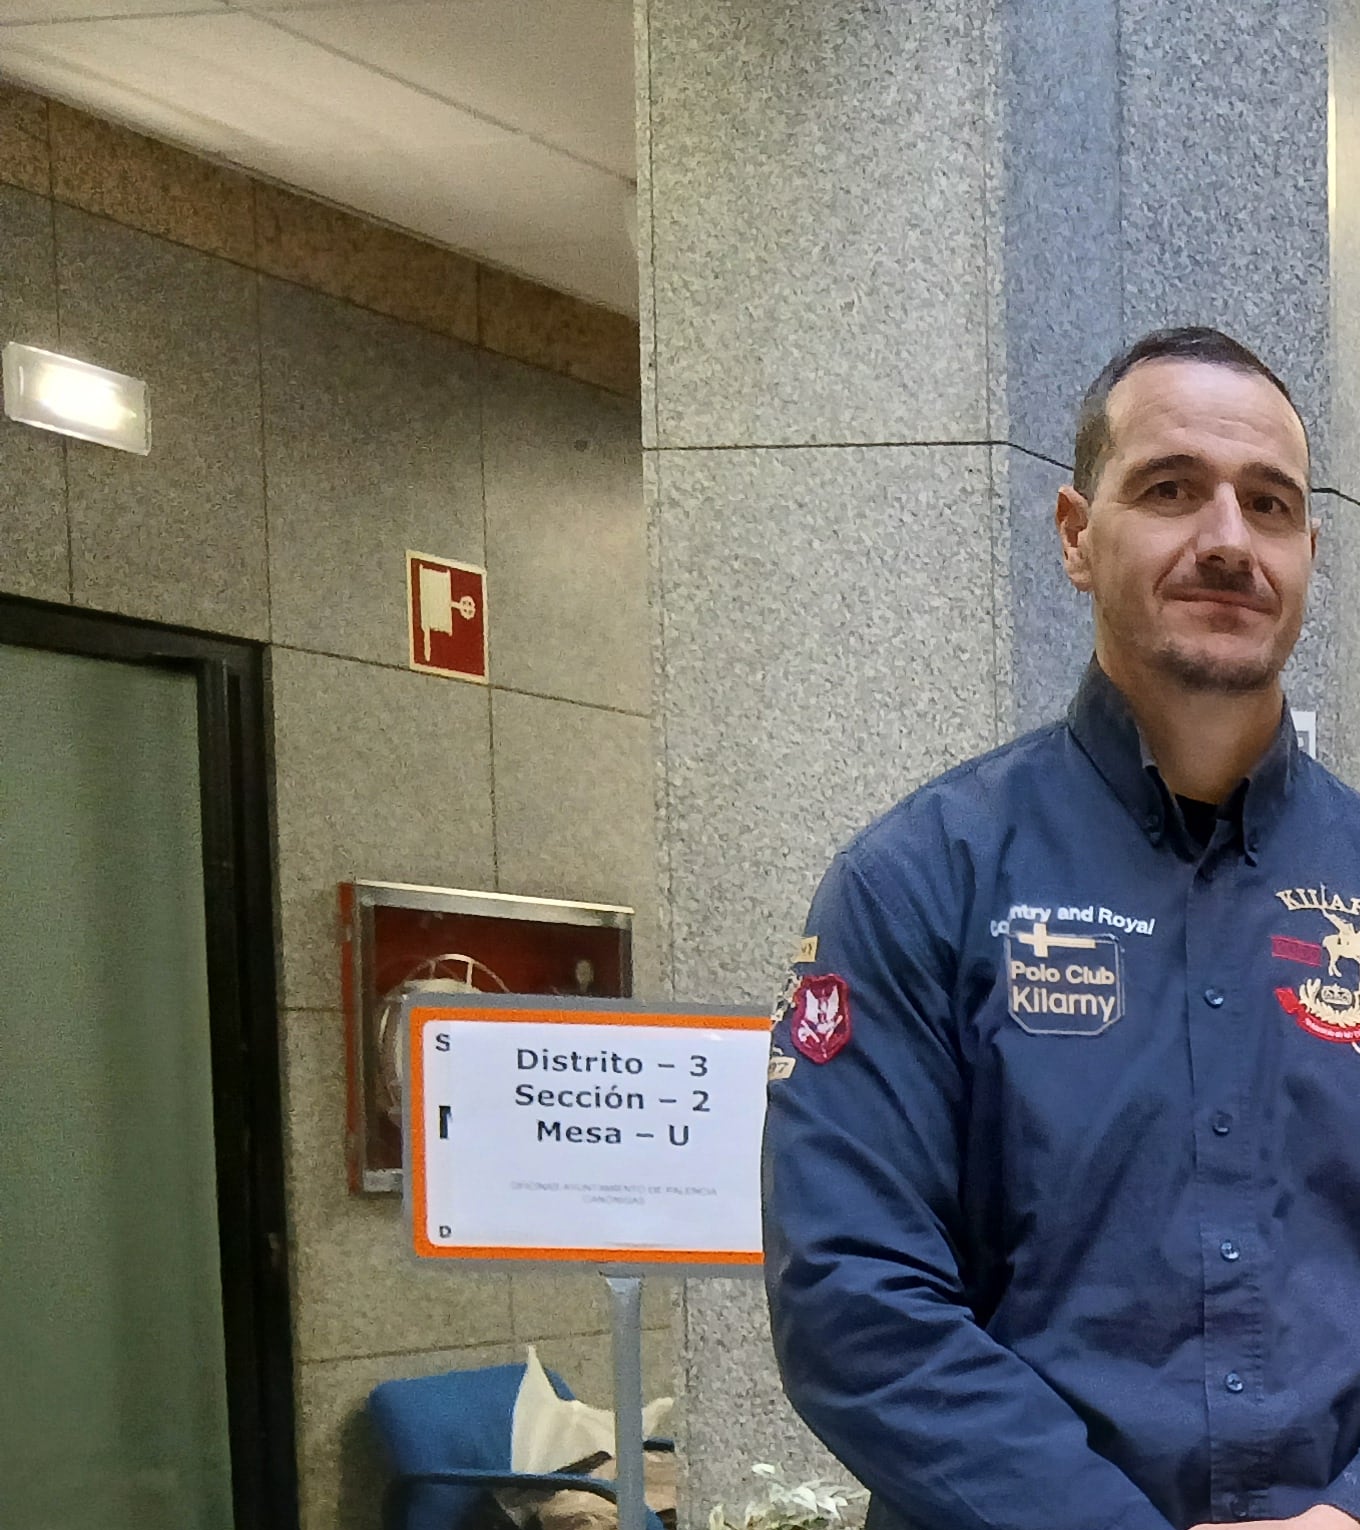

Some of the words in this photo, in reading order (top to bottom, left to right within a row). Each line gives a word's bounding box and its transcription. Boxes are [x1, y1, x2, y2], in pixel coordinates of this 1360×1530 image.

[1057, 905, 1093, 923] and
[1098, 907, 1155, 935] Royal
[1011, 960, 1060, 982] Polo
[1065, 965, 1115, 985] Club
[517, 1048, 643, 1074] Distrito
[689, 1055, 708, 1077] 3
[515, 1083, 644, 1110] Sección
[692, 1090, 710, 1112] 2
[536, 1119, 622, 1144] Mesa
[669, 1124, 689, 1146] U
